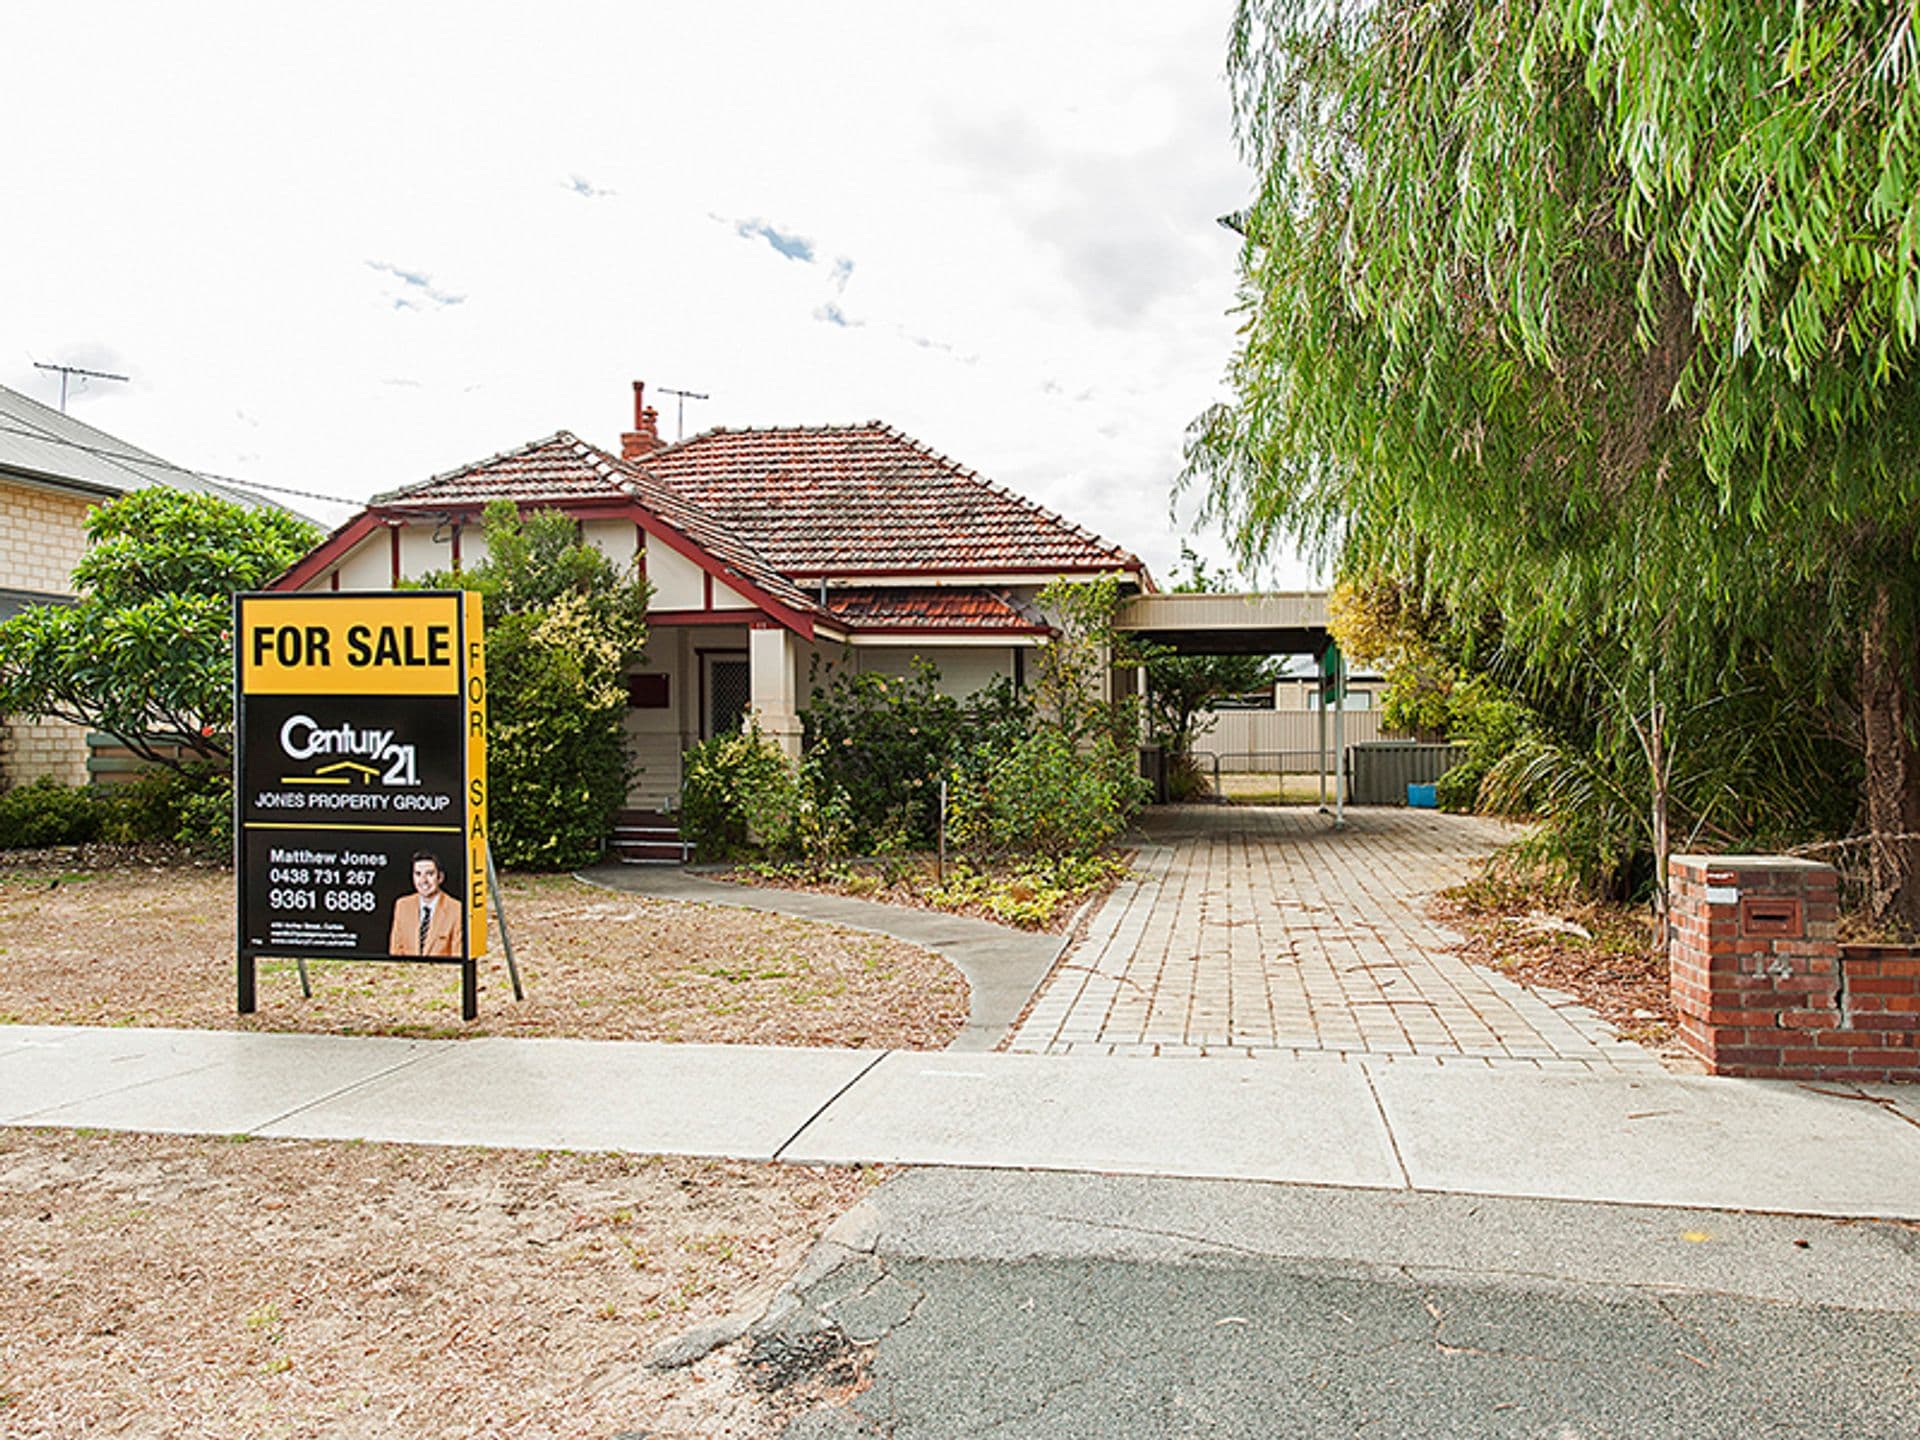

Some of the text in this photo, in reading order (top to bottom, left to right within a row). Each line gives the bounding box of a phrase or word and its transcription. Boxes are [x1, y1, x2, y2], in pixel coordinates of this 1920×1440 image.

[253, 626, 451, 667] FOR SALE
[280, 714, 394, 760] Century
[468, 642, 485, 908] FOR SALE
[254, 792, 450, 812] JONES PROPERTY GROUP
[270, 849, 388, 866] Matthew Jones
[269, 868, 376, 886] 0438 731 267
[269, 889, 377, 912] 9361 6888
[1752, 951, 1793, 980] 14
